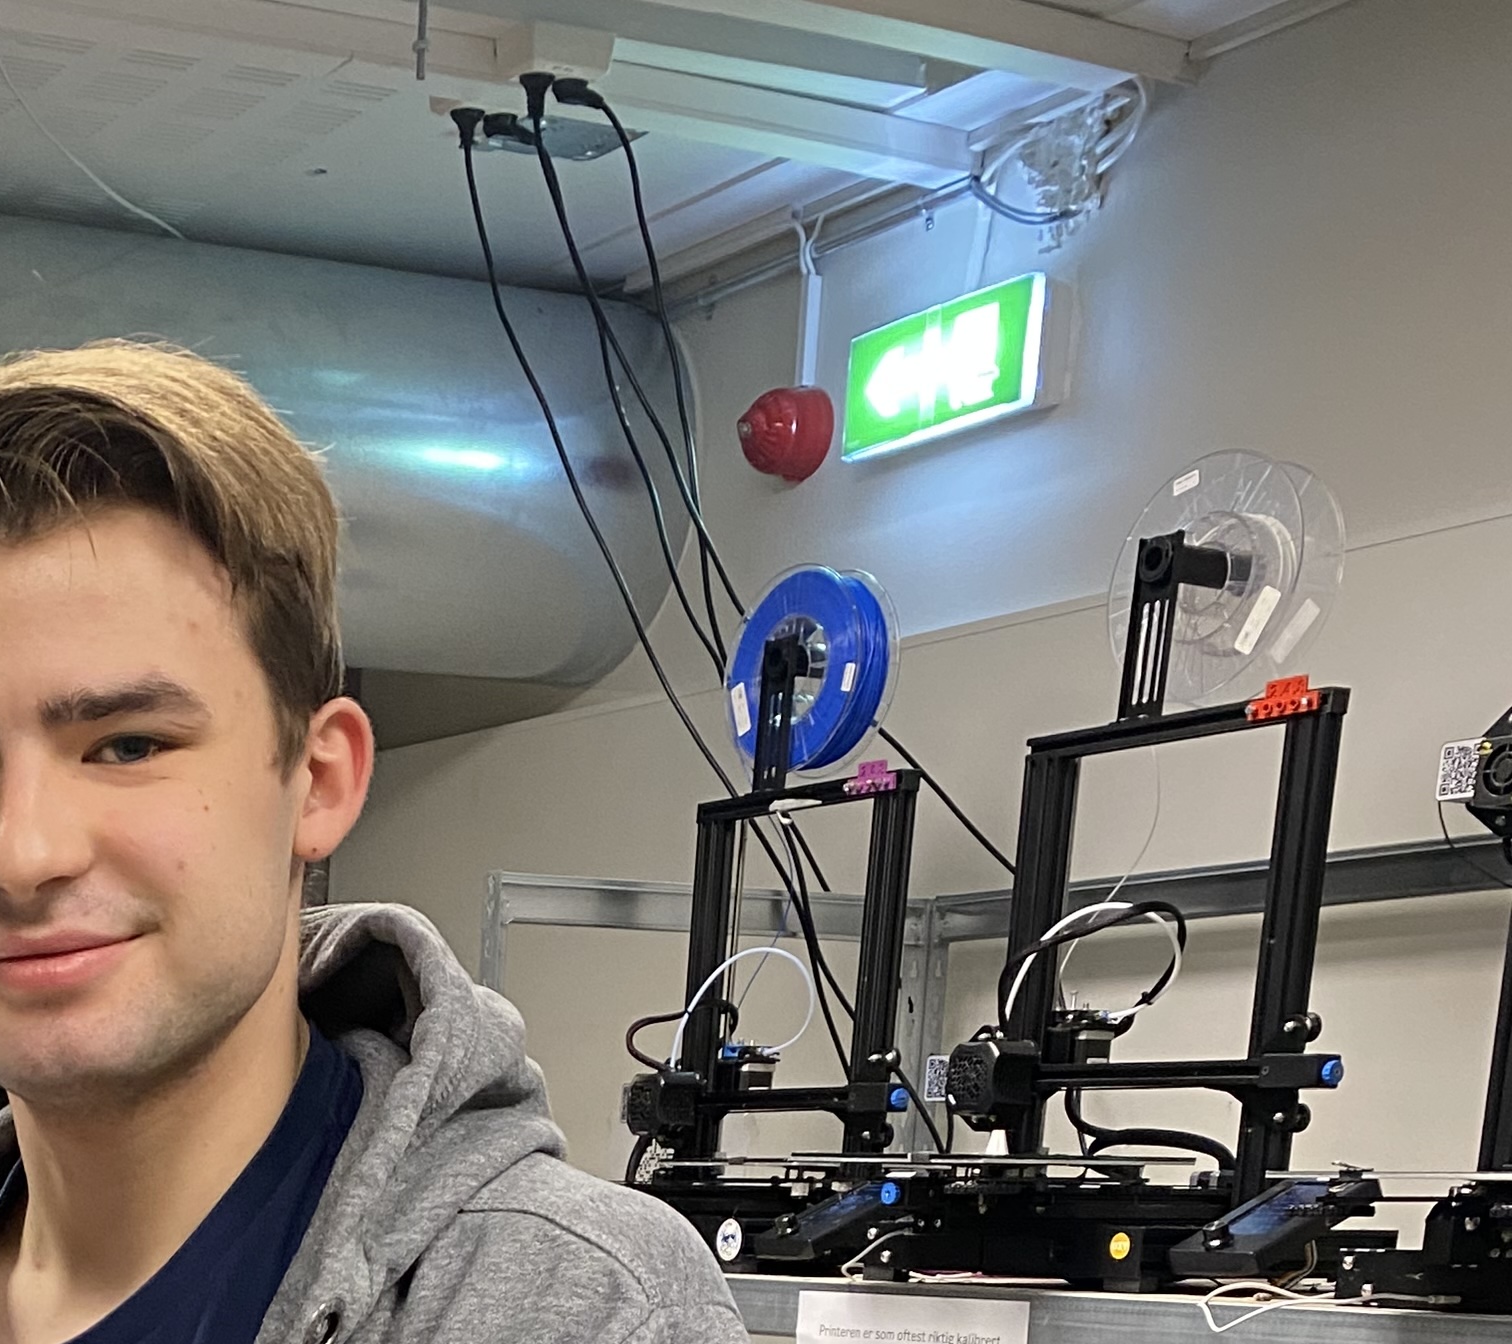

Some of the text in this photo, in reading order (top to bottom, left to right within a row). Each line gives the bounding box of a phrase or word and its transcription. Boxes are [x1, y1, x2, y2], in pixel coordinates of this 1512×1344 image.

[819, 1323, 861, 1338] Printeren
[863, 1329, 873, 1339] er
[875, 1330, 895, 1340] som
[897, 1328, 926, 1343] oftest
